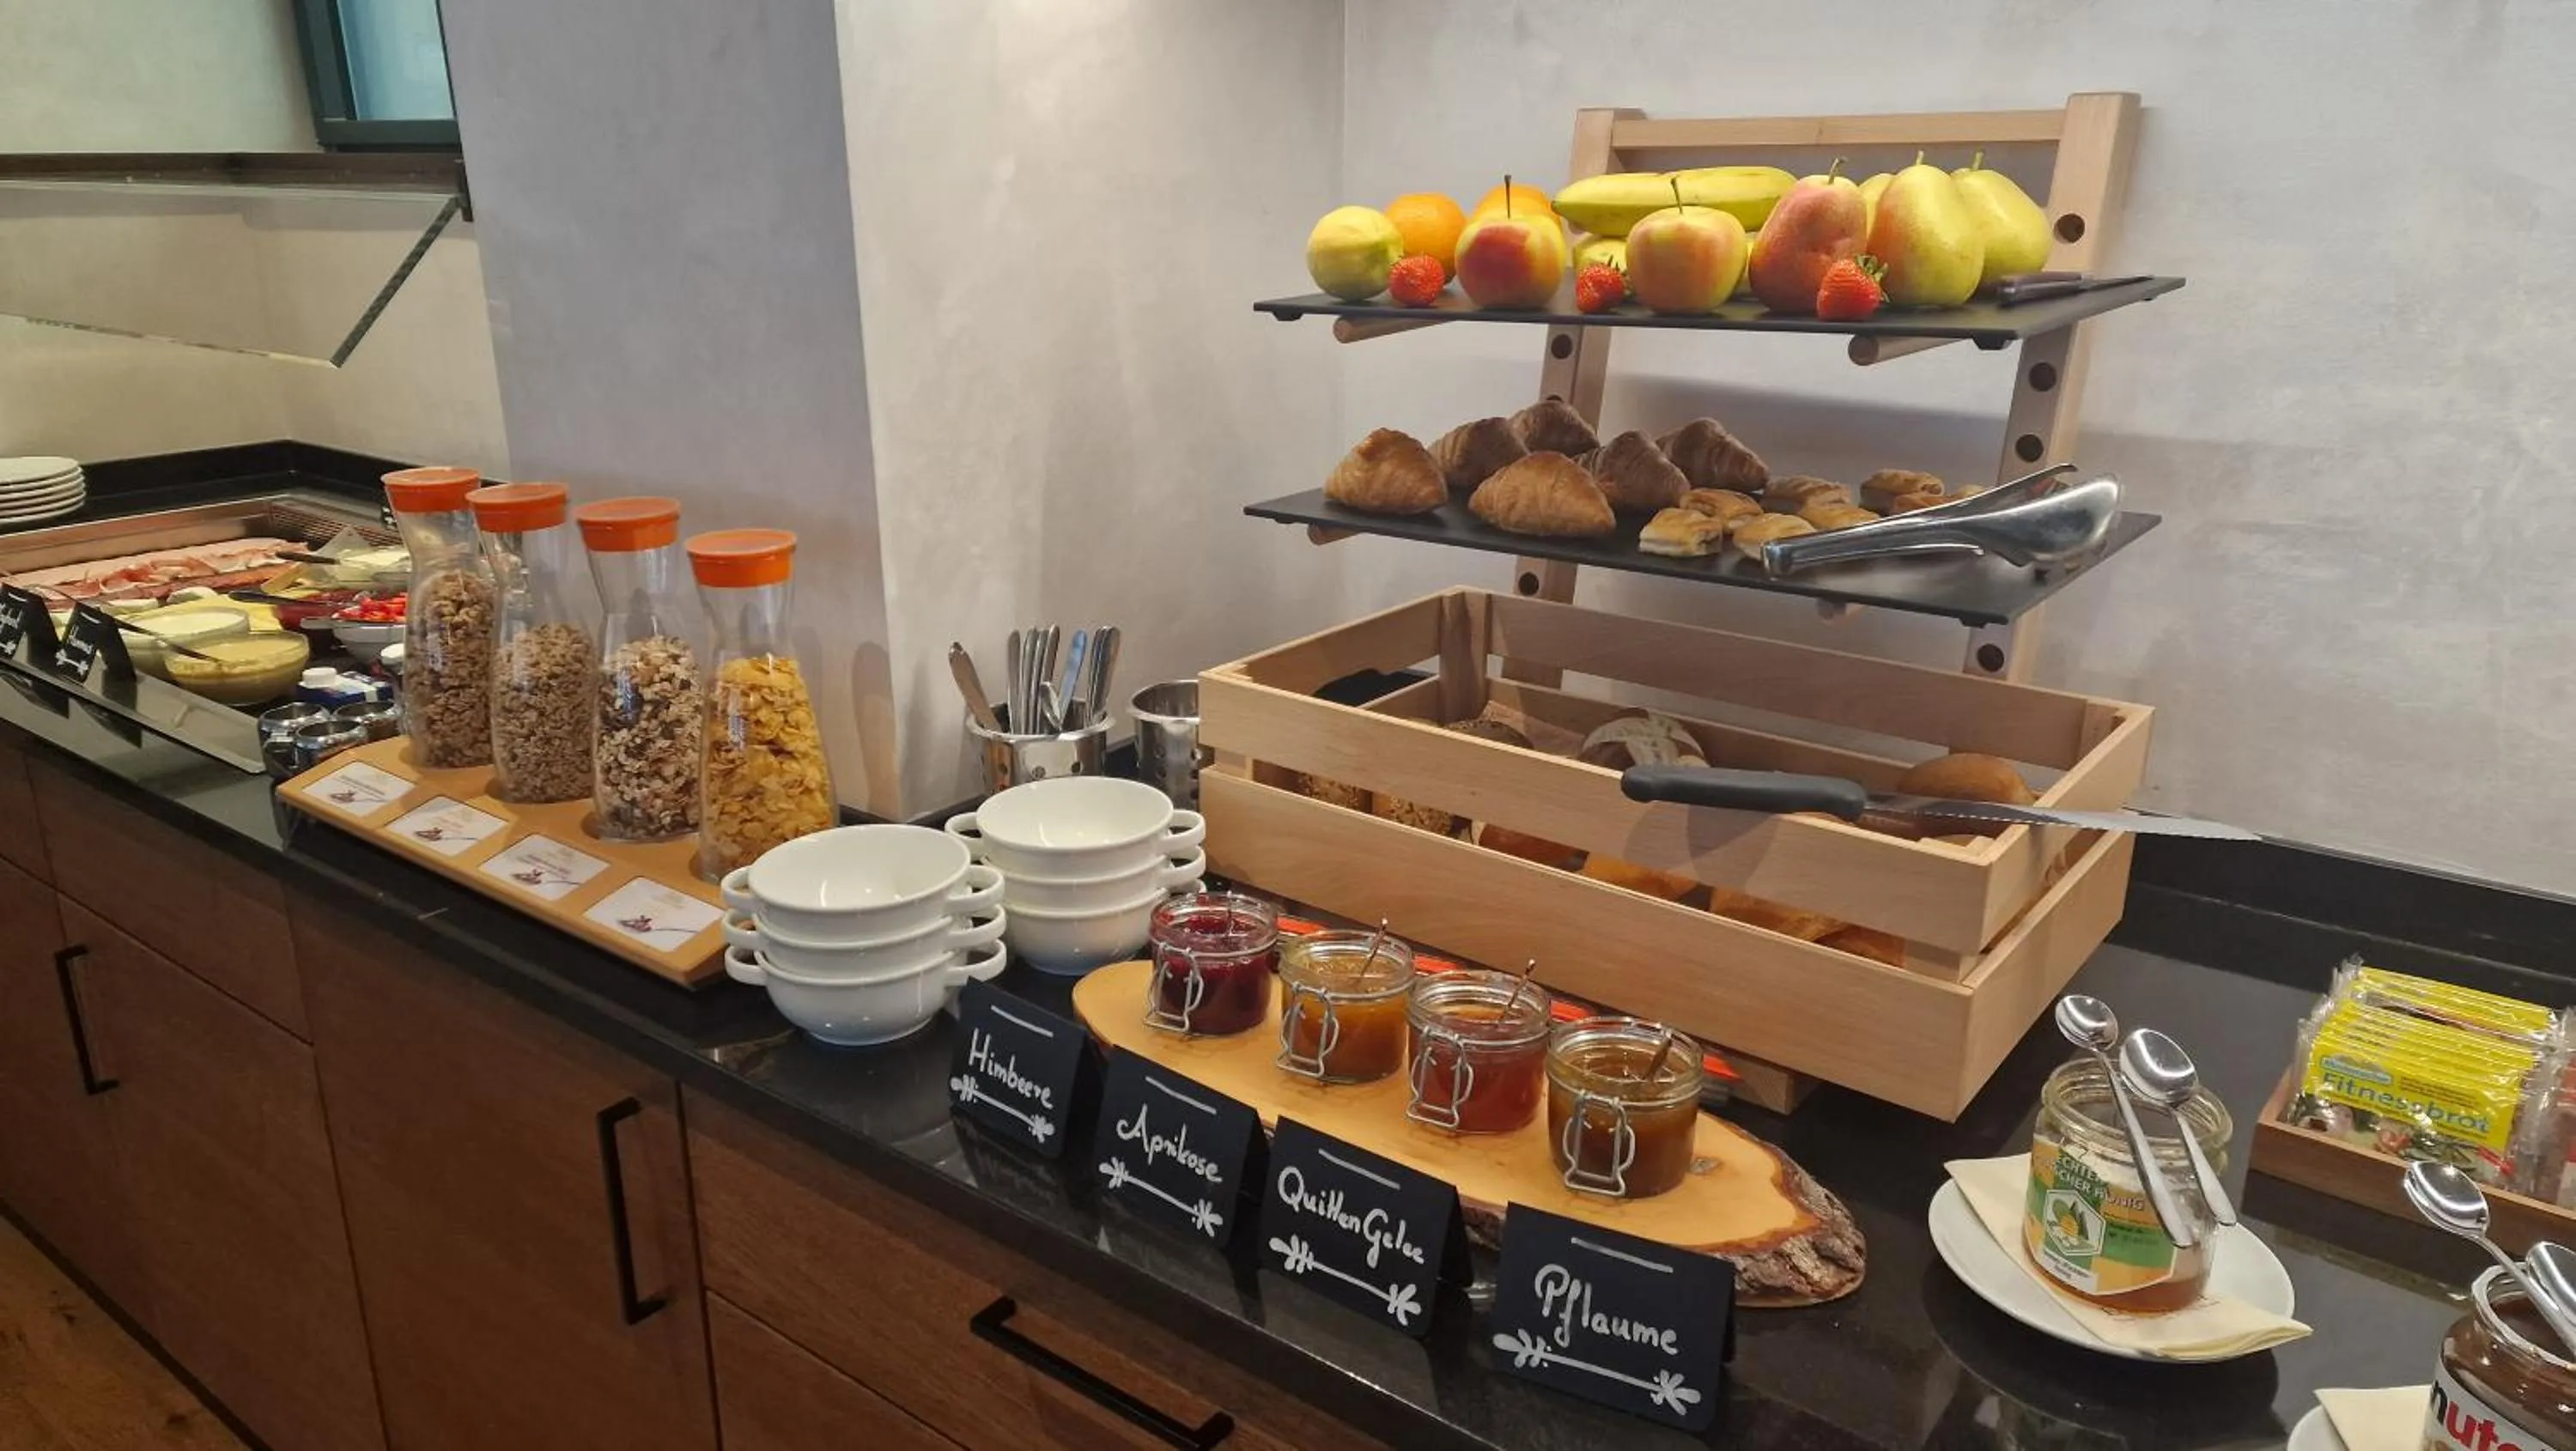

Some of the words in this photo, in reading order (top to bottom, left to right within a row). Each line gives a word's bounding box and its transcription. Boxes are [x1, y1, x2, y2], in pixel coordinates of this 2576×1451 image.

[969, 1028, 1054, 1109] Himbeere
[1116, 1103, 1223, 1182] Aprikose
[1534, 1263, 1680, 1356] Pflaume
